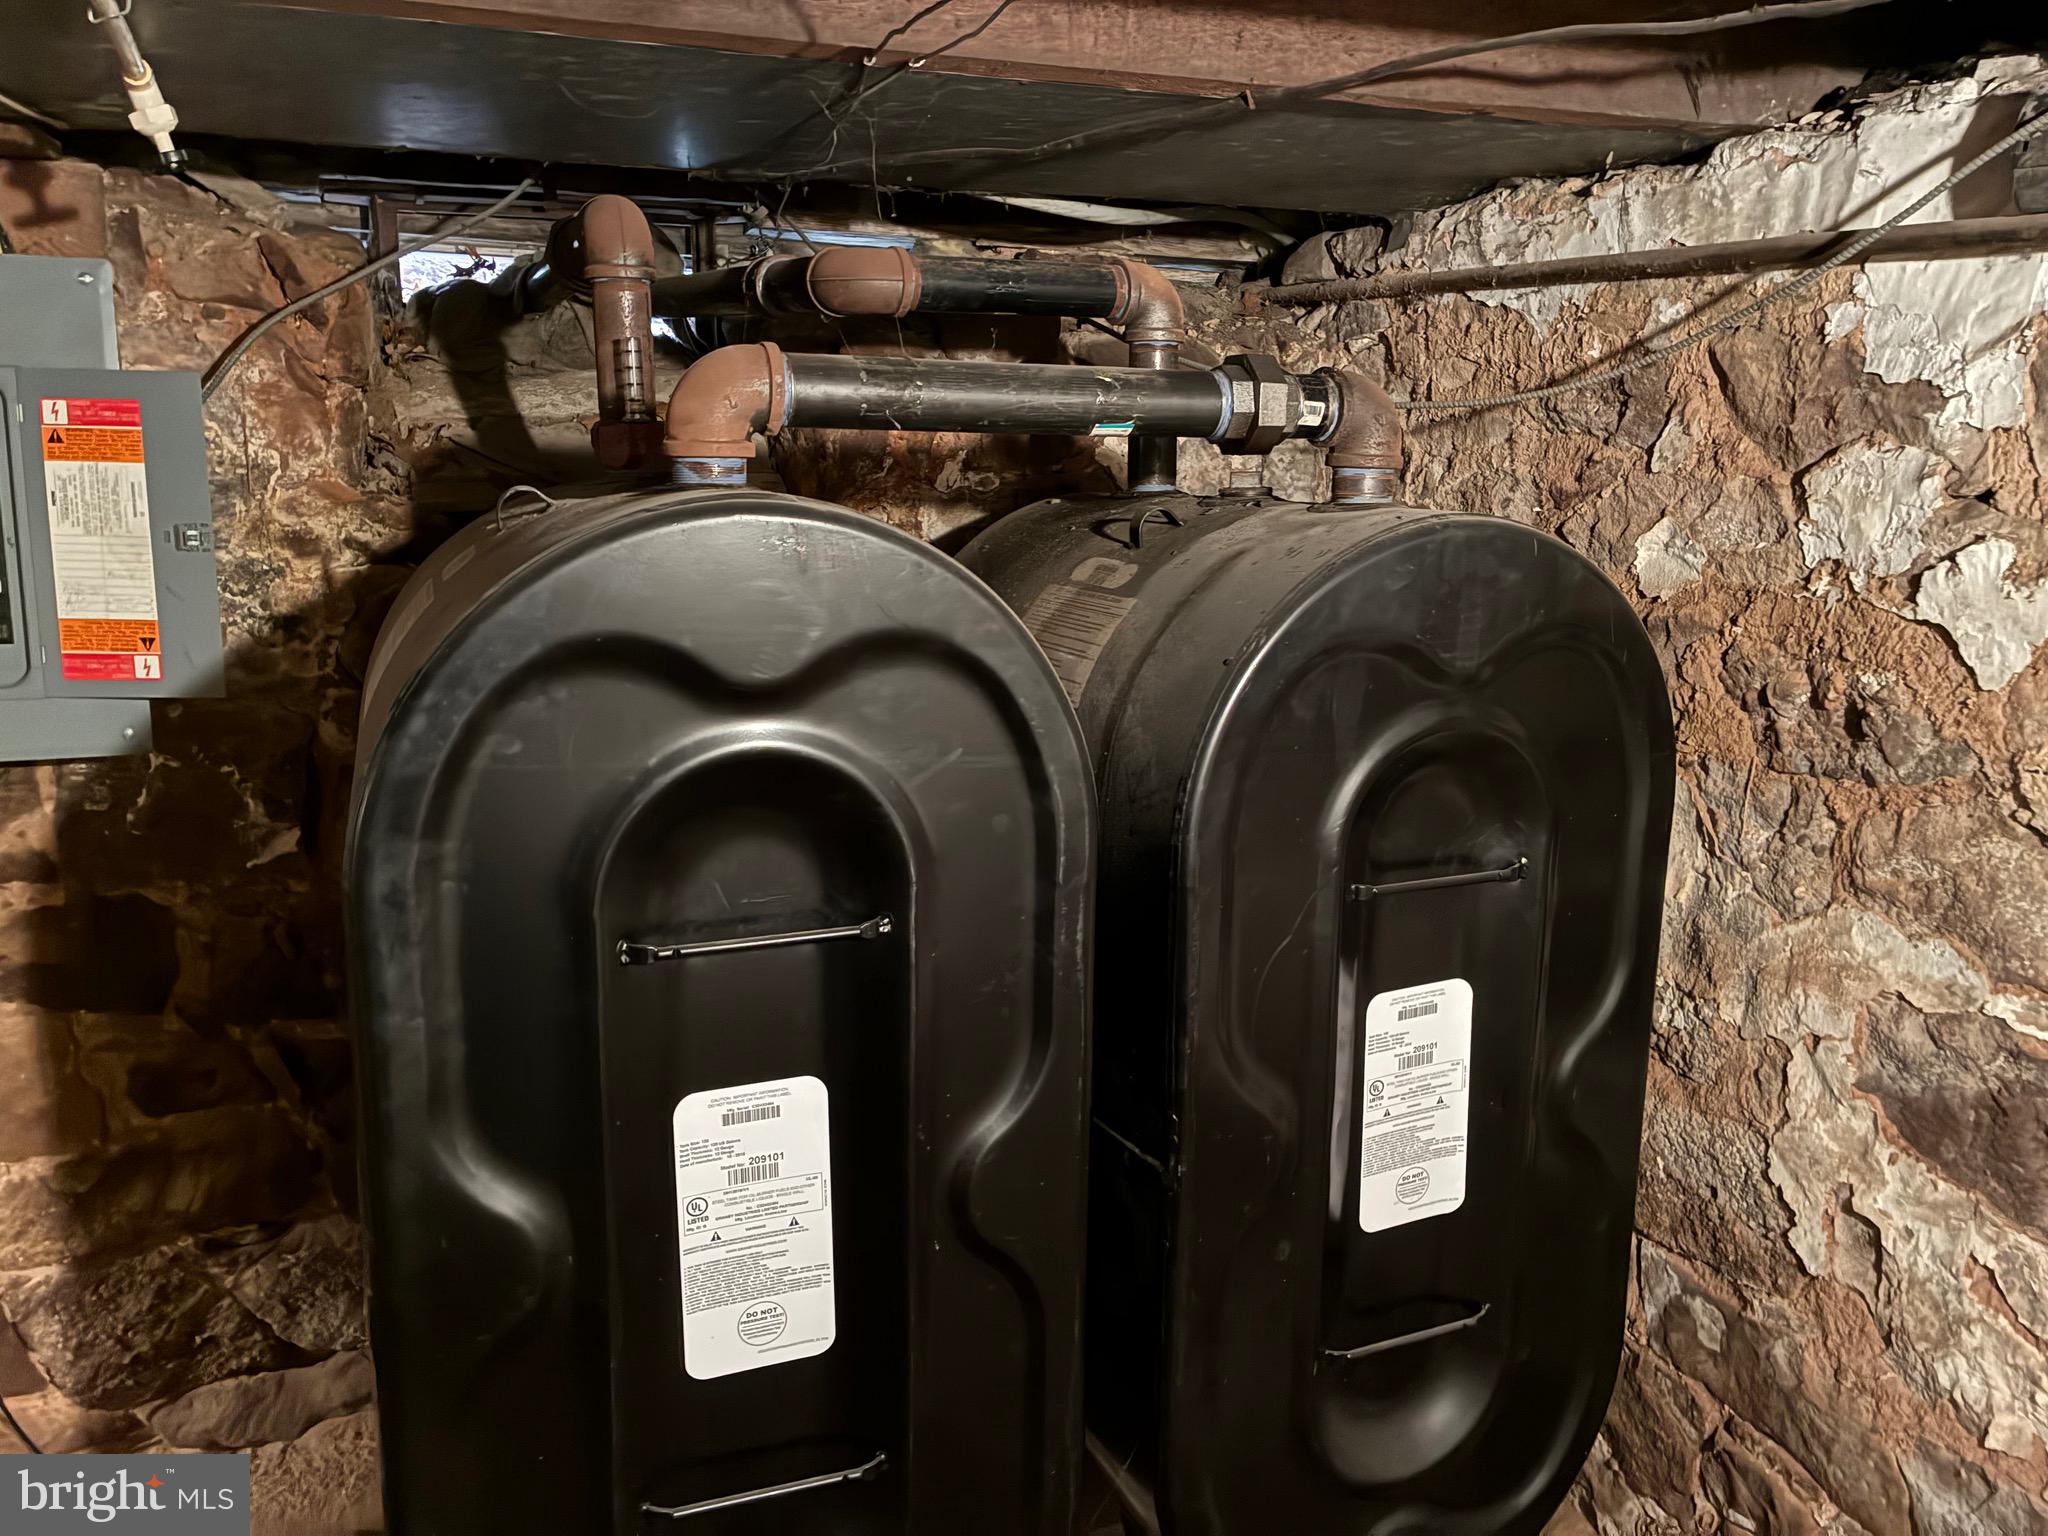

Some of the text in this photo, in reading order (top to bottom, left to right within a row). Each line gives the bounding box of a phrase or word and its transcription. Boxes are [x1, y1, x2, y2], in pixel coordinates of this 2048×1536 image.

[1413, 1042, 1438, 1054] 209101
[749, 1152, 784, 1165] 209101
[691, 1202, 703, 1213] UL
[687, 1215, 709, 1225] LISTED
[761, 1307, 778, 1316] NOT
